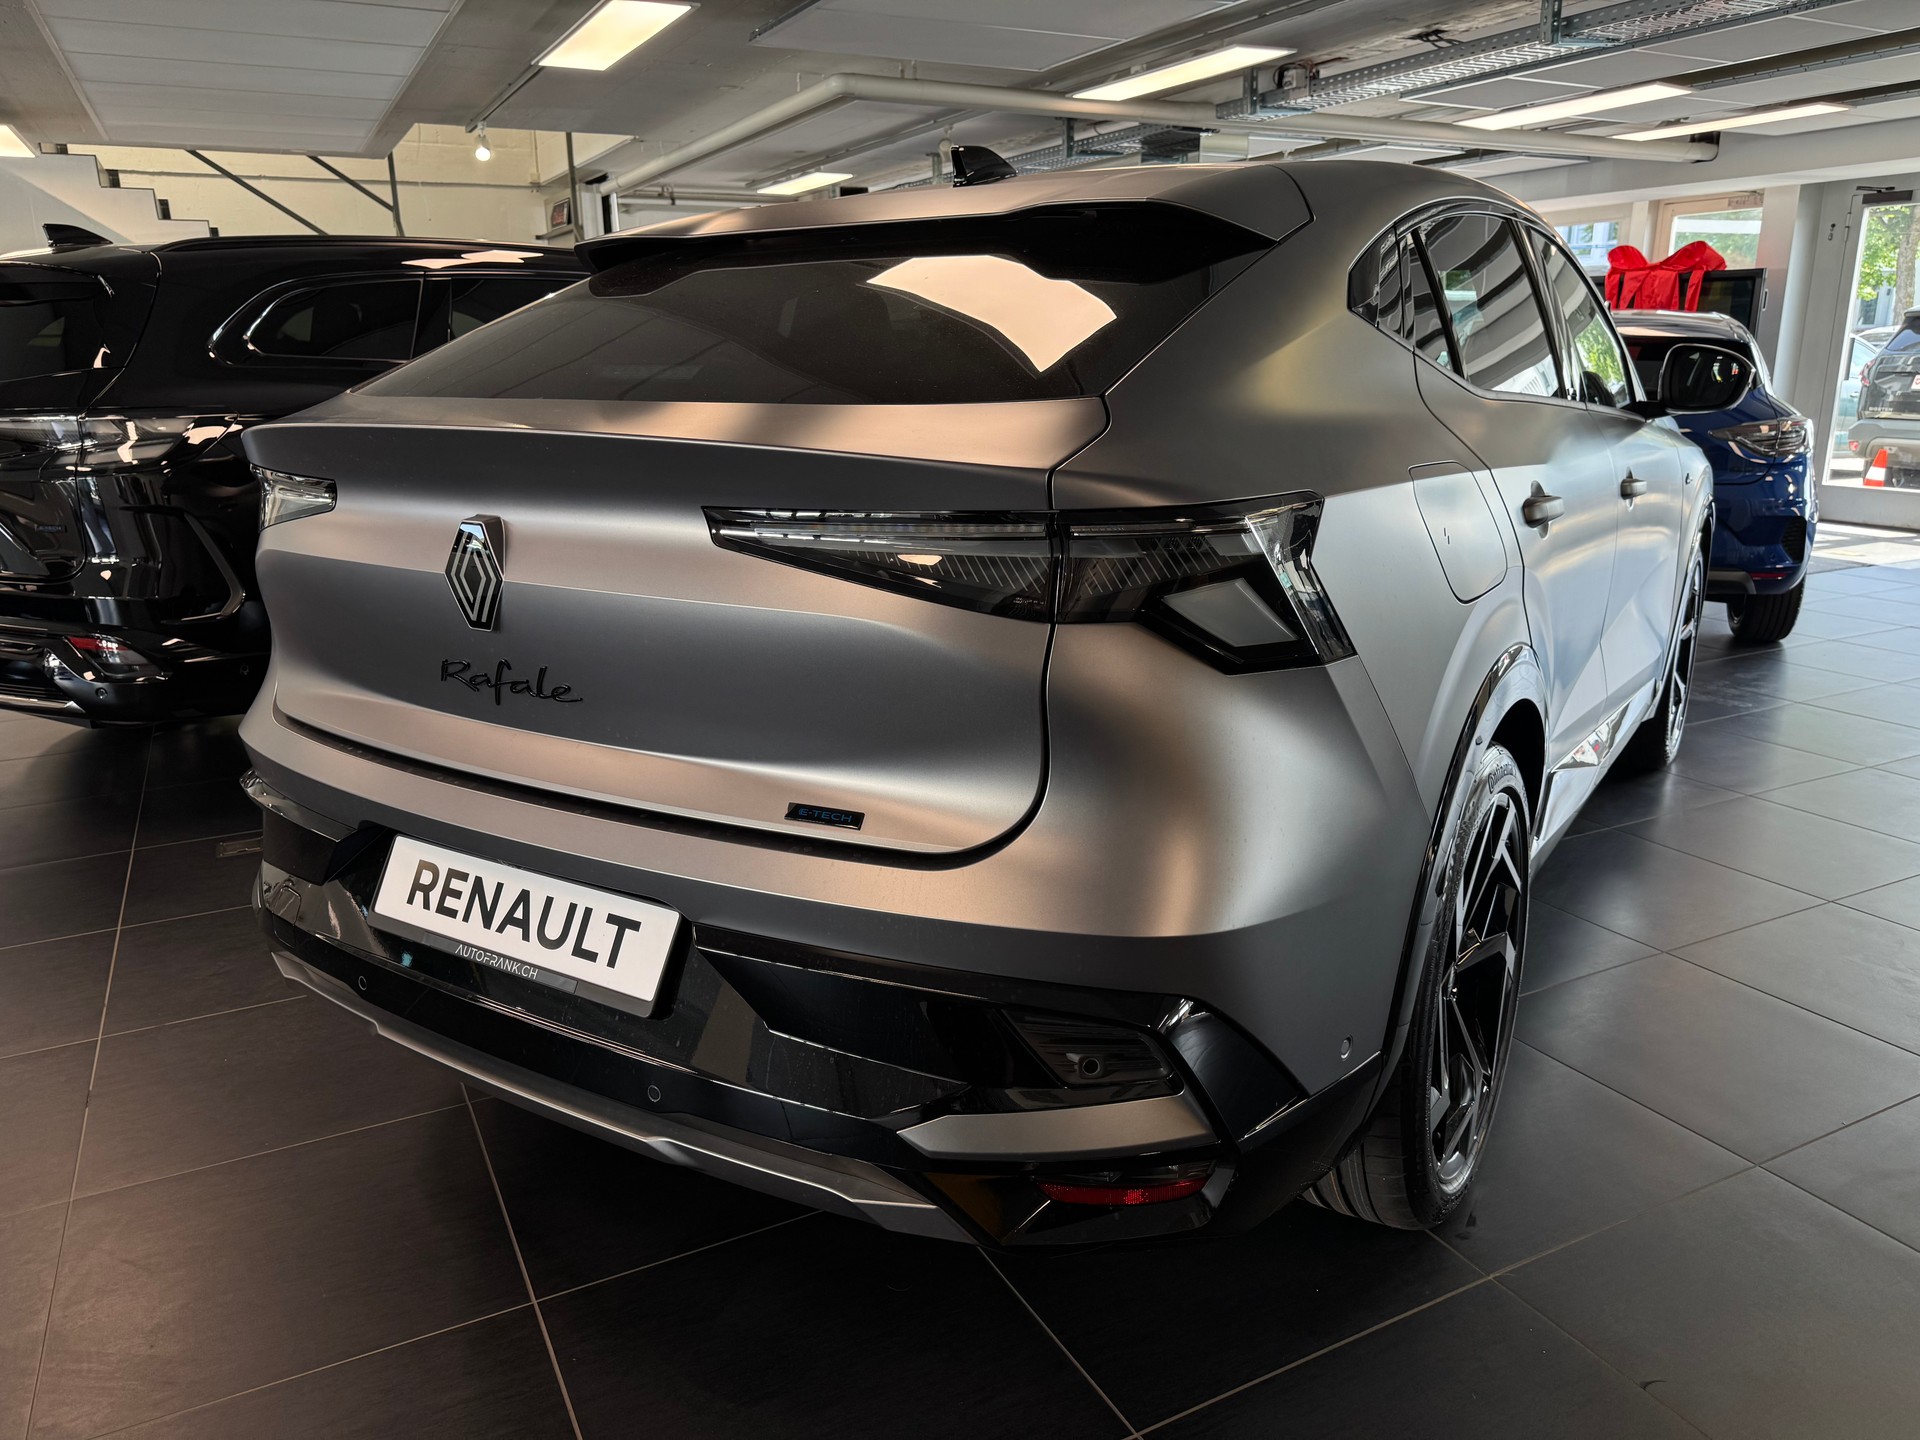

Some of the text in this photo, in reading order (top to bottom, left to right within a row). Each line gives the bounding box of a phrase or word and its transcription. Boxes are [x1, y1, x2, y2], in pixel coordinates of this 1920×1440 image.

[441, 659, 583, 705] Rafale
[798, 807, 853, 822] E-TECH
[406, 859, 642, 969] RENAULT
[455, 944, 539, 980] AUTOFRANK.CH
